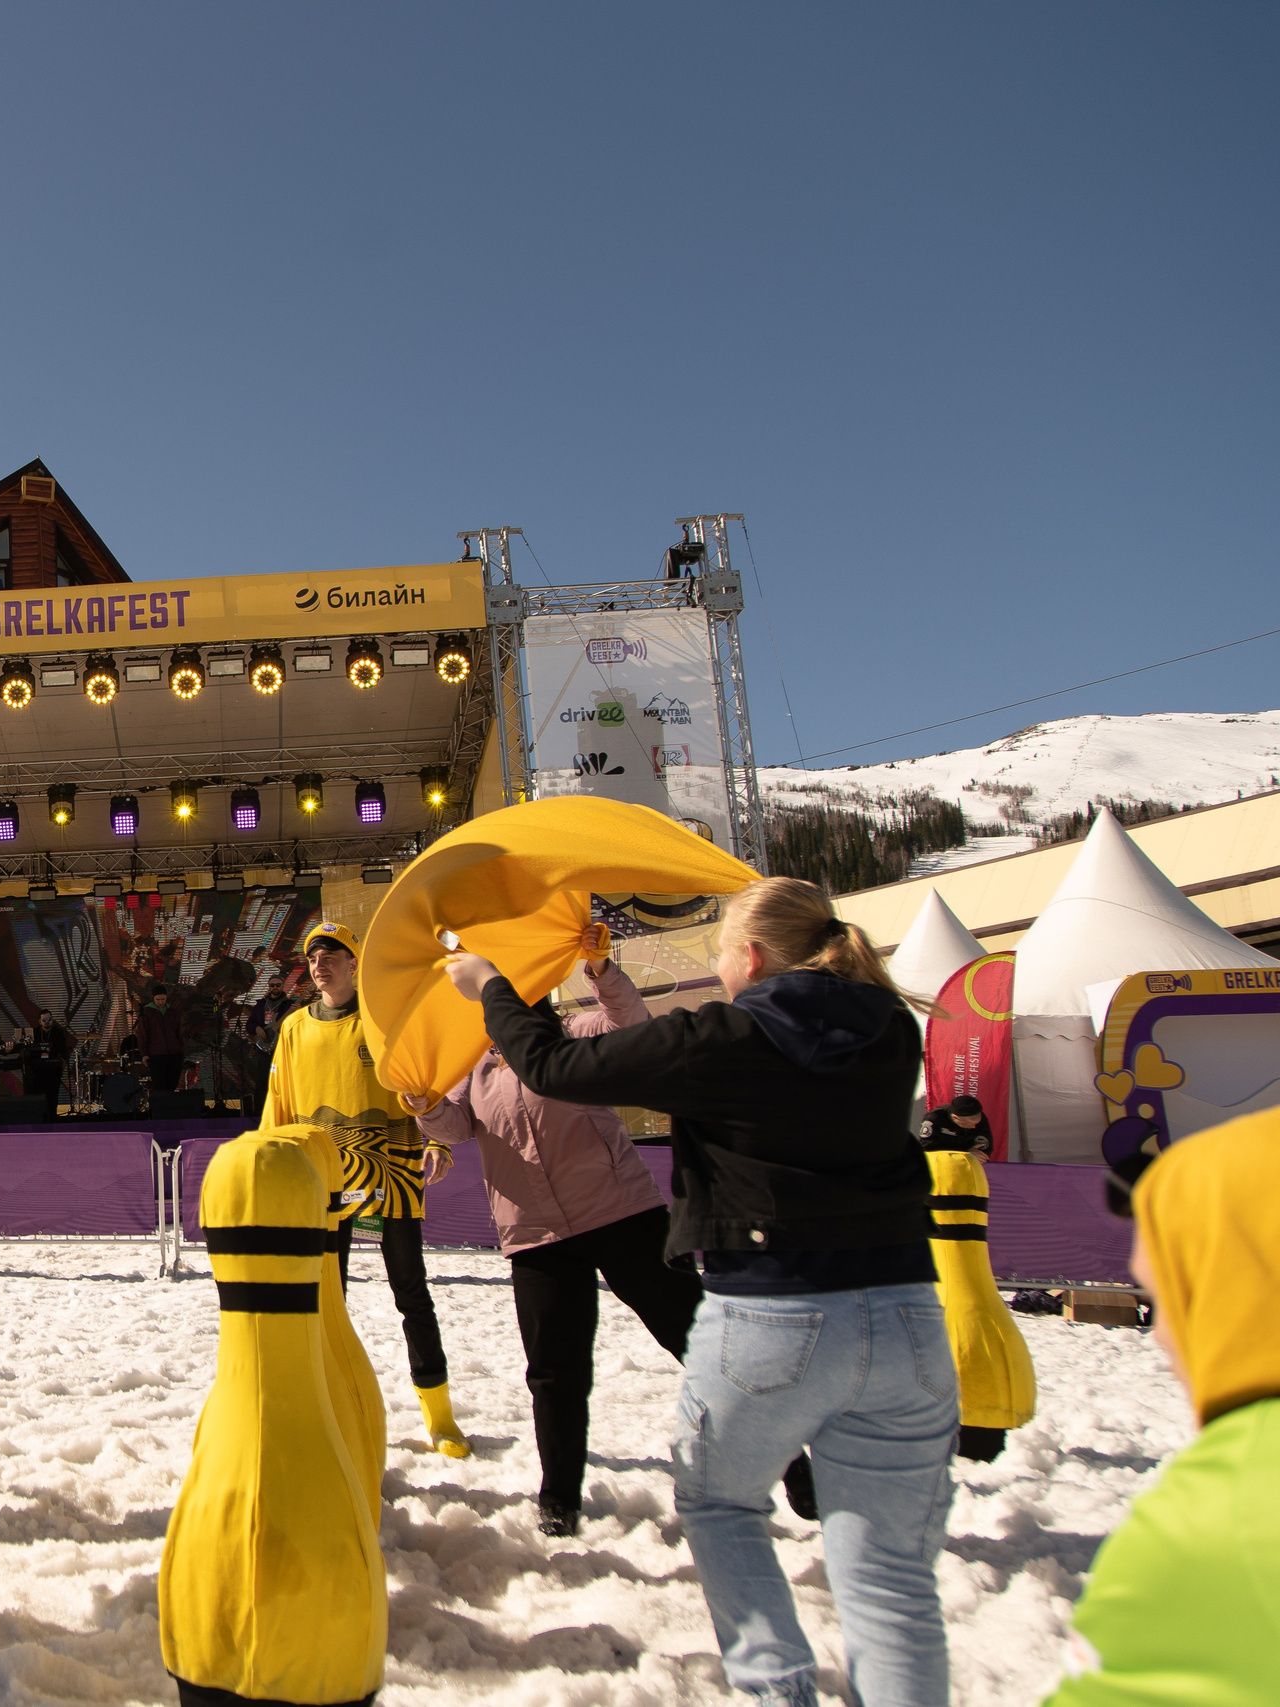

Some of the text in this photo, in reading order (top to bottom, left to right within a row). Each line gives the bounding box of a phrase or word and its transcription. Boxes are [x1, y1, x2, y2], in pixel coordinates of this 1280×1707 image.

[327, 583, 426, 609] билайн
[591, 640, 621, 651] GRELKA
[592, 651, 613, 661] FEST
[560, 706, 625, 723] drivee
[969, 1036, 980, 1073] FESTIVAL
